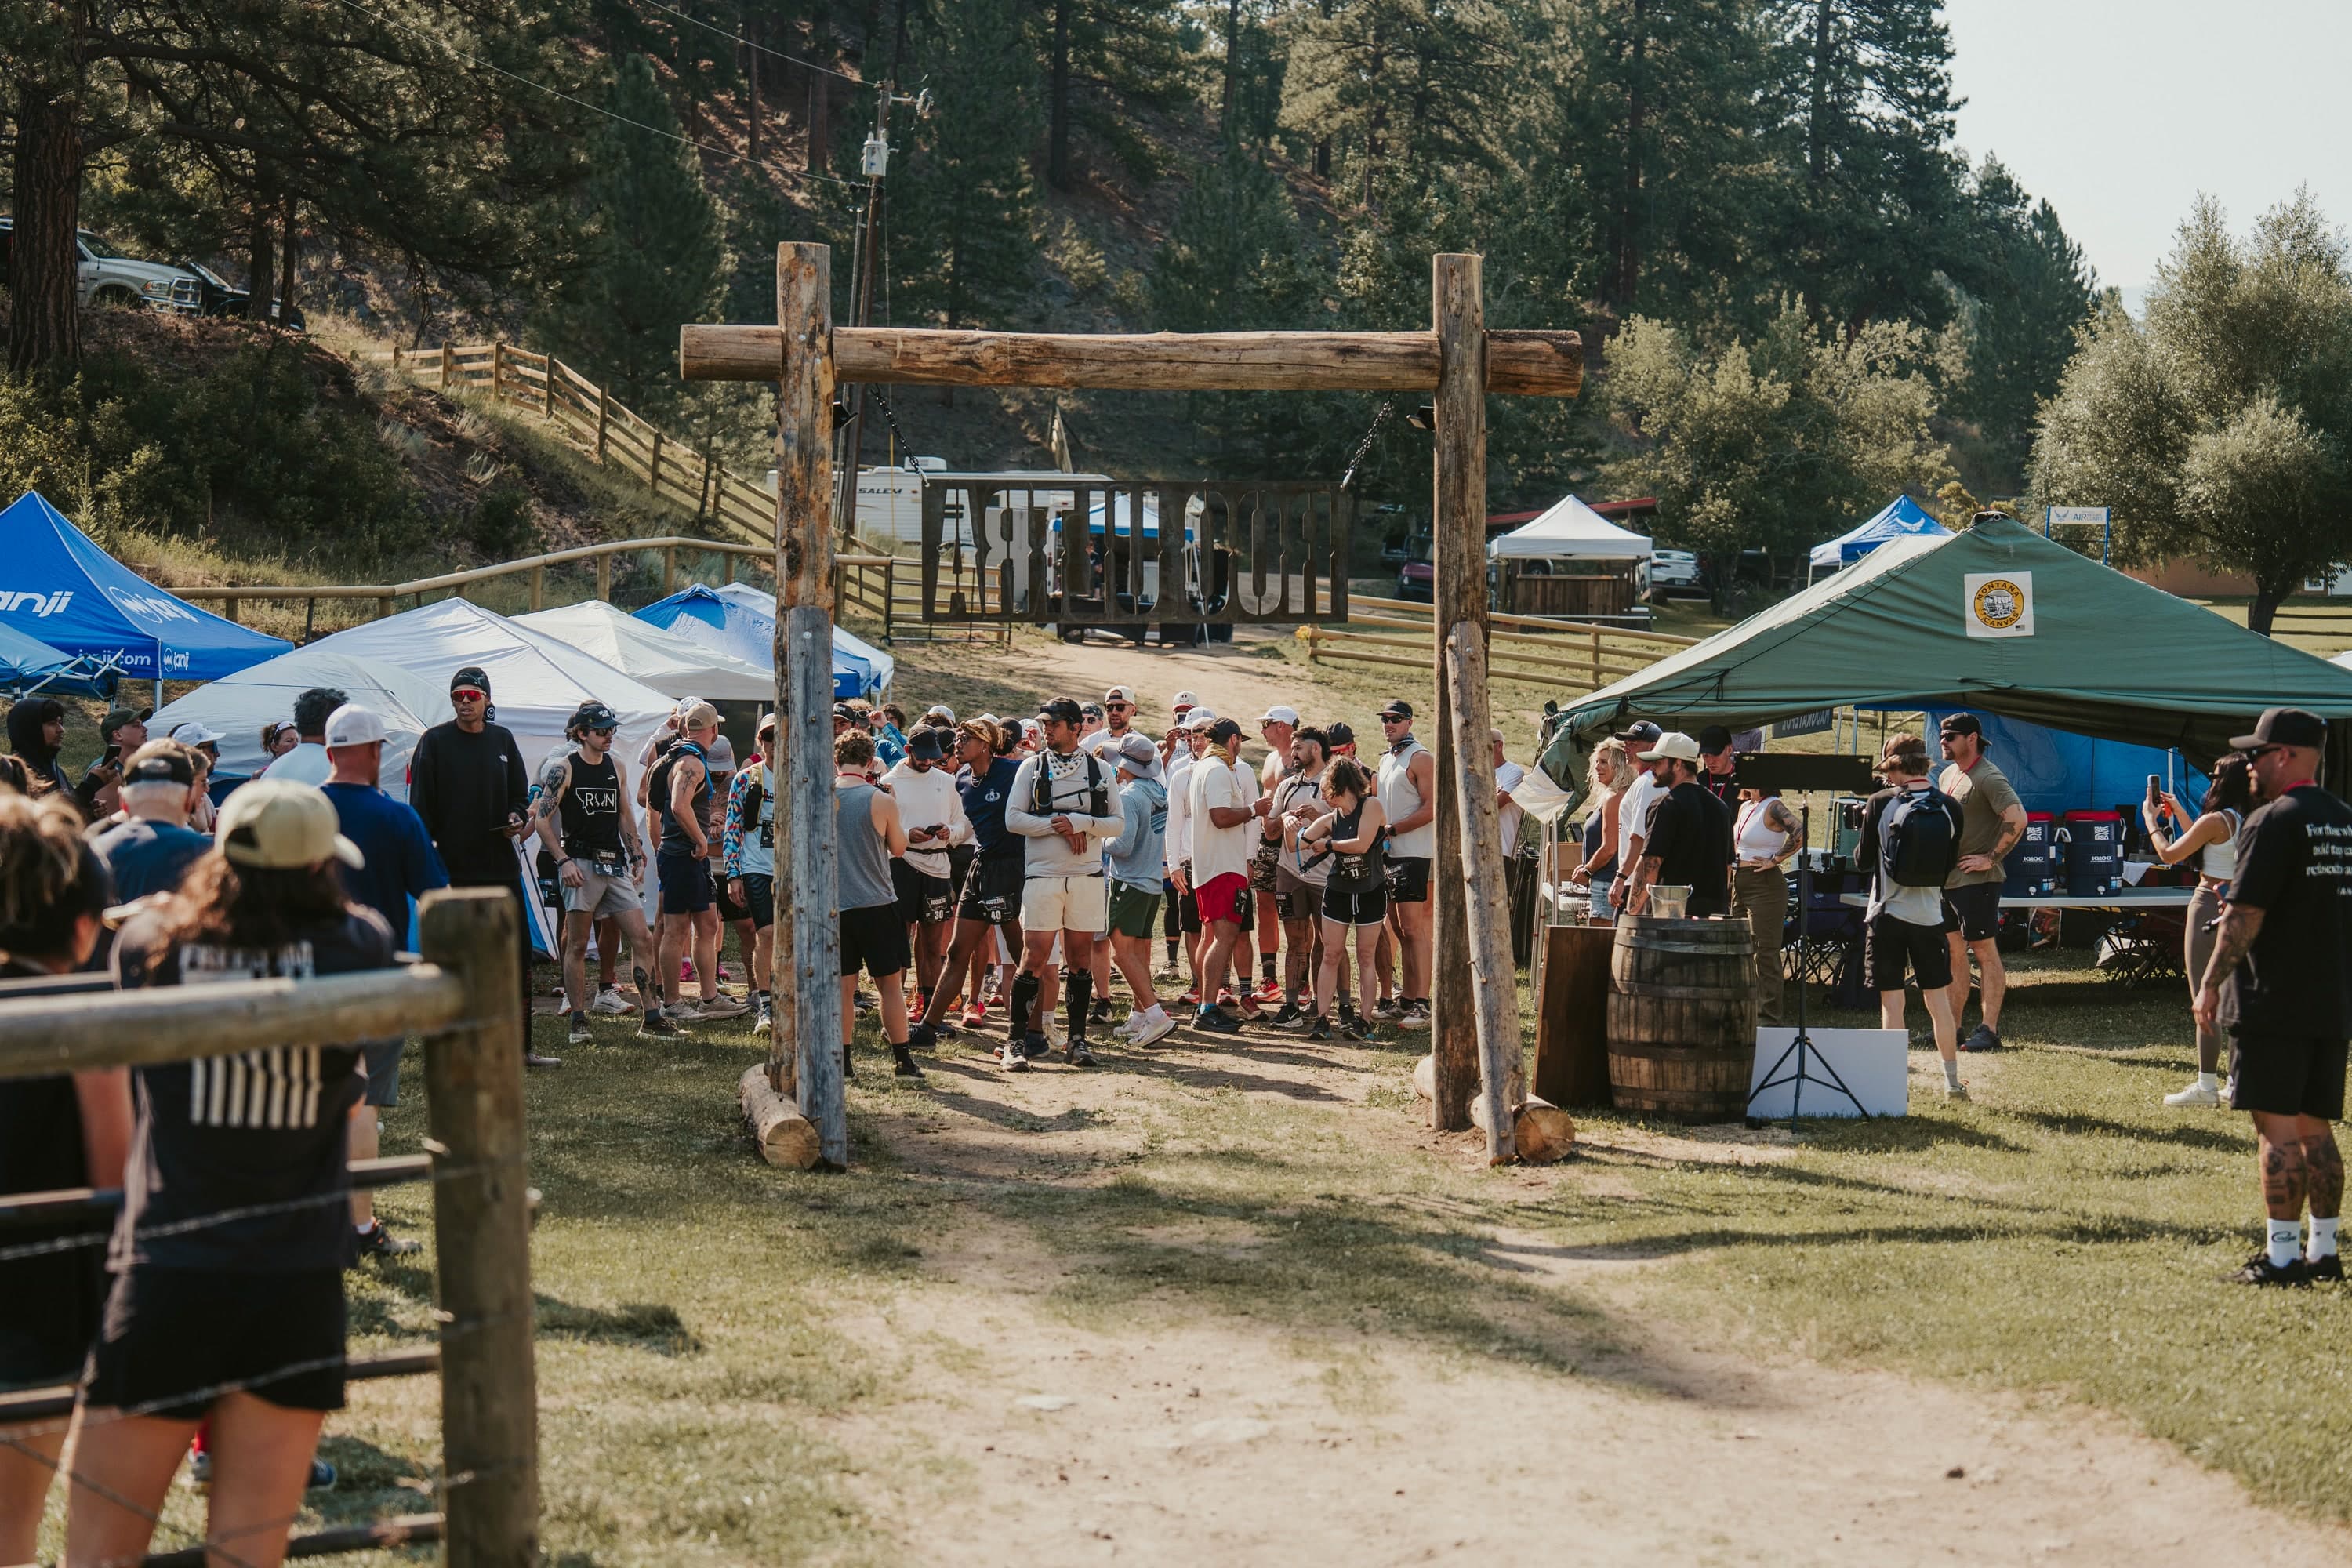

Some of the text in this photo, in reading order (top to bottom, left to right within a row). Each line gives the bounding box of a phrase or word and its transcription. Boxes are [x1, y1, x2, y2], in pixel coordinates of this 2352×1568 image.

[1976, 582, 2020, 601] MONTANA
[1984, 612, 2019, 627] CANVAS
[1349, 867, 1359, 877] 11
[934, 909, 944, 920] 30
[990, 910, 1002, 920] 40
